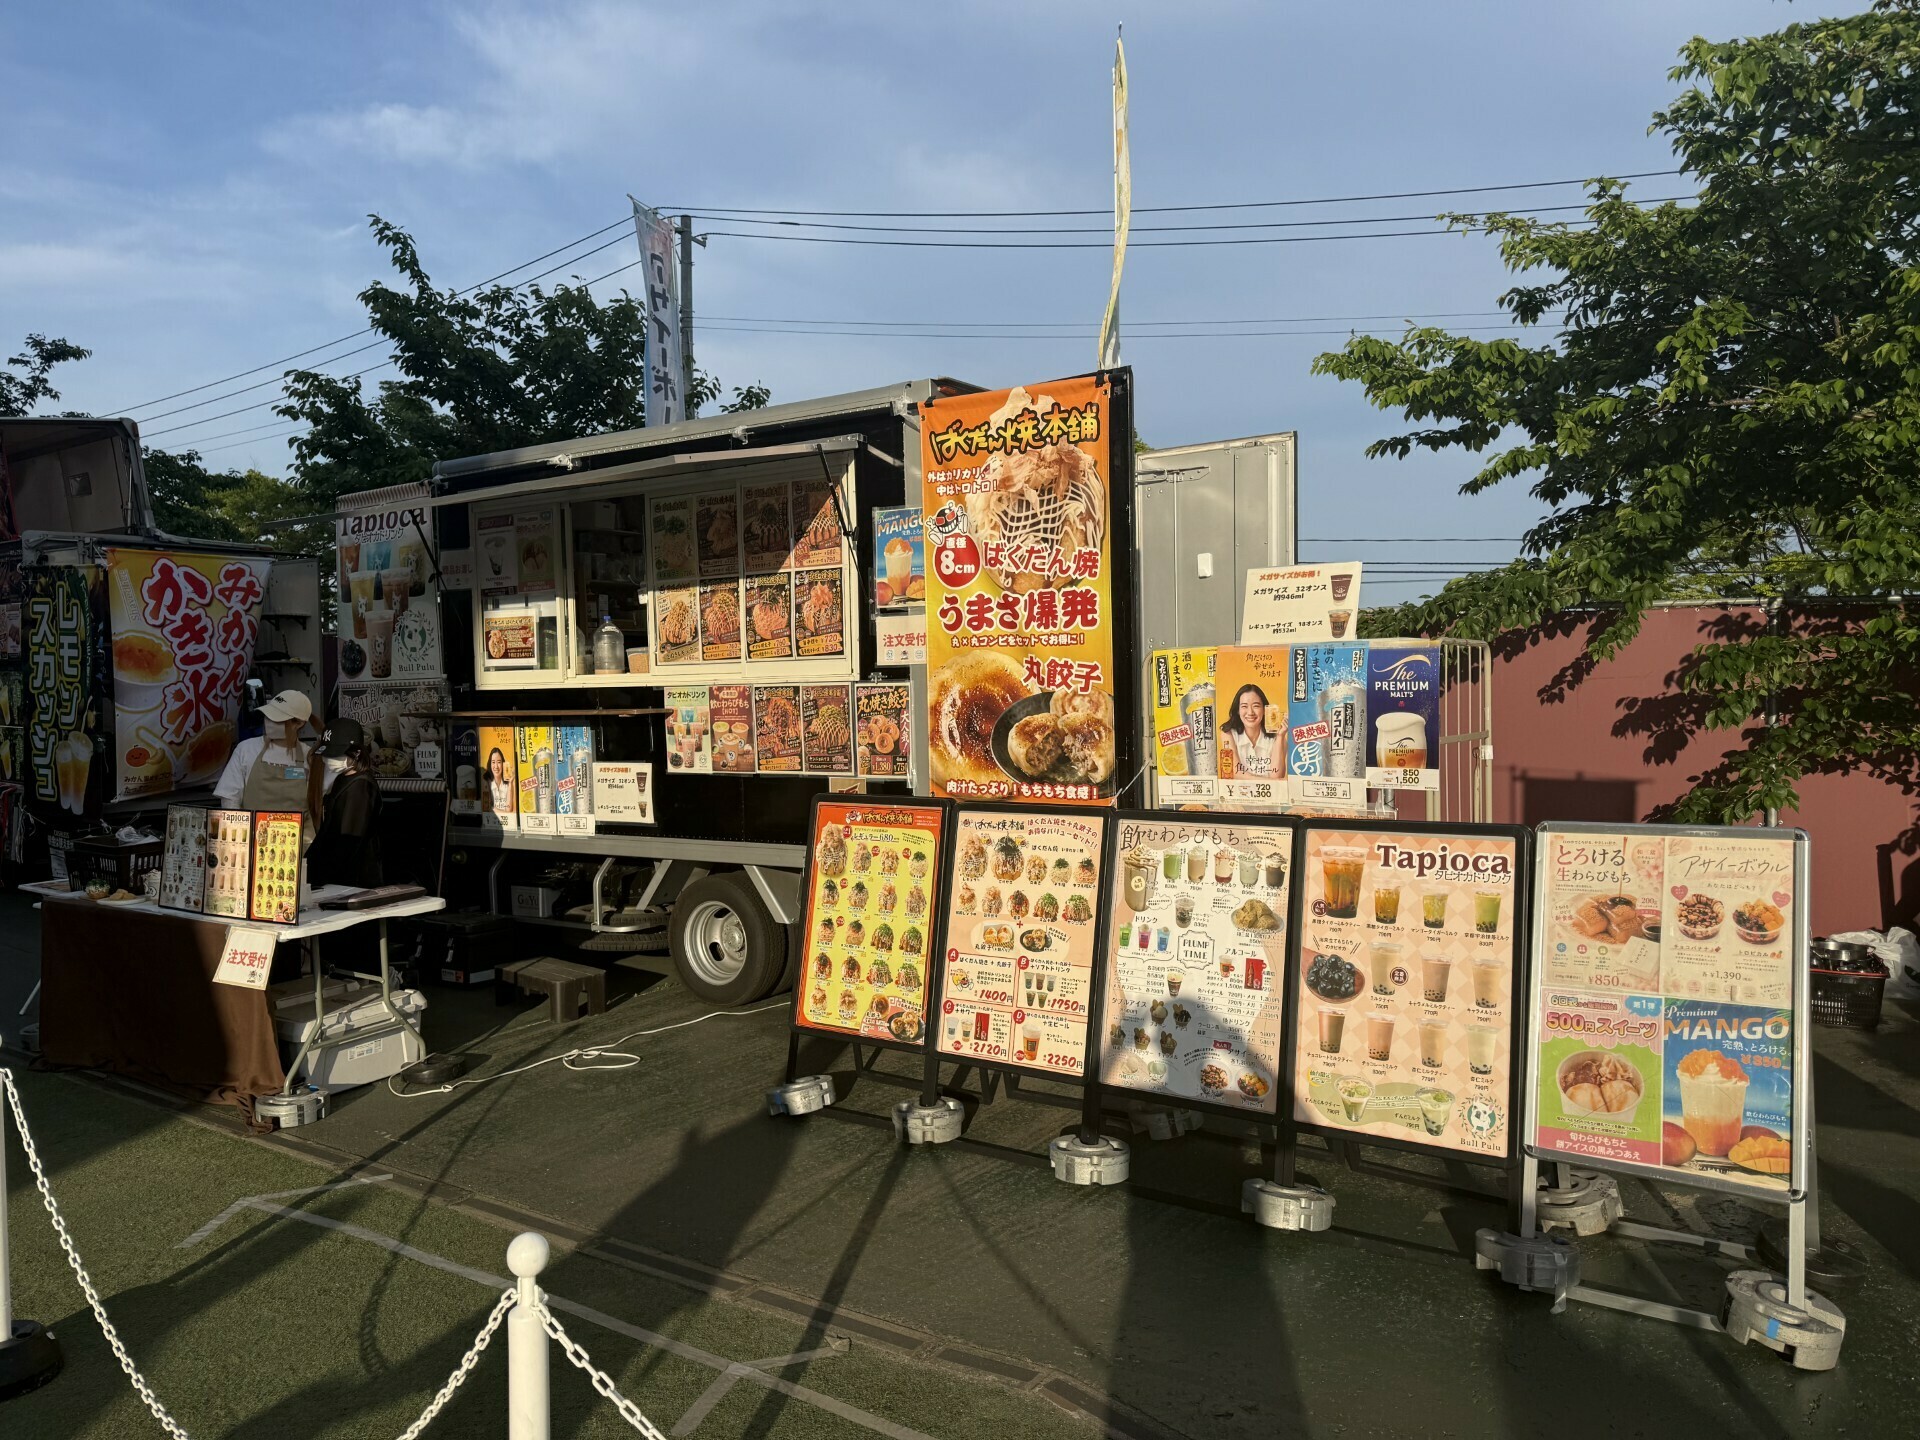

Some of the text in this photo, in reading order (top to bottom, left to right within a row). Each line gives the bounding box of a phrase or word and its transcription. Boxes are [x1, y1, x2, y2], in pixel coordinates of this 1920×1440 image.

[929, 403, 1100, 465] ばくだん焼本舗
[946, 537, 967, 549] 直径
[940, 550, 975, 575] 8cm
[983, 540, 1100, 579] ばくだん焼
[1253, 584, 1327, 595] メガサイズ 32オンス
[1273, 593, 1304, 601] 約946ml
[938, 588, 1099, 633] うまさ爆発
[215, 562, 263, 699] みかん
[1249, 622, 1293, 630] レギュラーサイズ
[883, 633, 926, 647] 注文受付
[57, 582, 82, 730] レモン
[141, 557, 227, 745] かき氷
[1246, 653, 1272, 662] 角だけの
[1182, 652, 1192, 670] 酒の
[1022, 655, 1103, 694] 丸餃子
[1172, 653, 1184, 697] うまさに
[1295, 650, 1306, 700] こだわり酒場
[1389, 664, 1418, 681] The
[1157, 657, 1169, 705] こだわり酒場
[1375, 681, 1429, 691] PREMIUM
[30, 598, 58, 801] スカッシュ
[667, 691, 706, 699] タピオカドリンク
[858, 688, 909, 713] 丸焼き餃子
[710, 699, 749, 709] 飲むわらびもち
[1161, 726, 1191, 744] 強炭酸
[1194, 711, 1204, 749] レモンサワー
[1294, 724, 1328, 740] 強炭酸
[1333, 710, 1343, 748] タコハイ
[1246, 755, 1271, 765] 幸せの
[1235, 763, 1279, 774] 角ハイボール
[222, 812, 250, 822] Tapioca
[1121, 824, 1240, 851] 飲むわらびもち
[1376, 844, 1511, 879] Tapioca
[1557, 845, 1625, 866] とろける
[1679, 855, 1789, 878] アサイーボウル
[1435, 870, 1511, 884] タピオカドリンク
[1557, 867, 1631, 883] 生わらびもち
[1464, 933, 1509, 941] 京都宇治抹茶ミルク
[1183, 940, 1209, 949] PLUMP
[1673, 944, 1709, 952] チョコバナナ
[226, 949, 268, 969] 注文受付
[1183, 949, 1208, 960] TIME
[1225, 948, 1257, 957] アルコール
[1588, 975, 1620, 986] ¥850
[1710, 971, 1742, 980] ¥1,390
[980, 989, 1007, 1002] 1400
[1051, 998, 1078, 1011] 1750
[1112, 998, 1147, 1008] ダブルアイス
[1408, 1001, 1455, 1010] キャラメルミルクティー
[1633, 1000, 1655, 1010] 第1弾
[1467, 1008, 1502, 1016] キャラメルミルク
[1664, 1006, 1718, 1018] Premium
[1546, 1012, 1657, 1038] 500円スイーツ
[1664, 1016, 1790, 1040] MANGO
[974, 1042, 1001, 1056] 2120
[1722, 1040, 1791, 1057] 完熟、とろける。
[1048, 1054, 1083, 1069] 2250 円
[1307, 1052, 1352, 1063] チョコレートミルクティー
[1362, 1061, 1398, 1070] チョコレートミルク
[1411, 1068, 1447, 1076] 杏仁ミルクティー
[1470, 1076, 1494, 1084] 杏仁ミルク
[1395, 1113, 1420, 1121] ずんだミルク
[1460, 1138, 1501, 1151] Bull Pulu
[1569, 1132, 1628, 1148] 旬わらびもちと
[1556, 1140, 1641, 1160] 餅アイスの黒みつあえ
